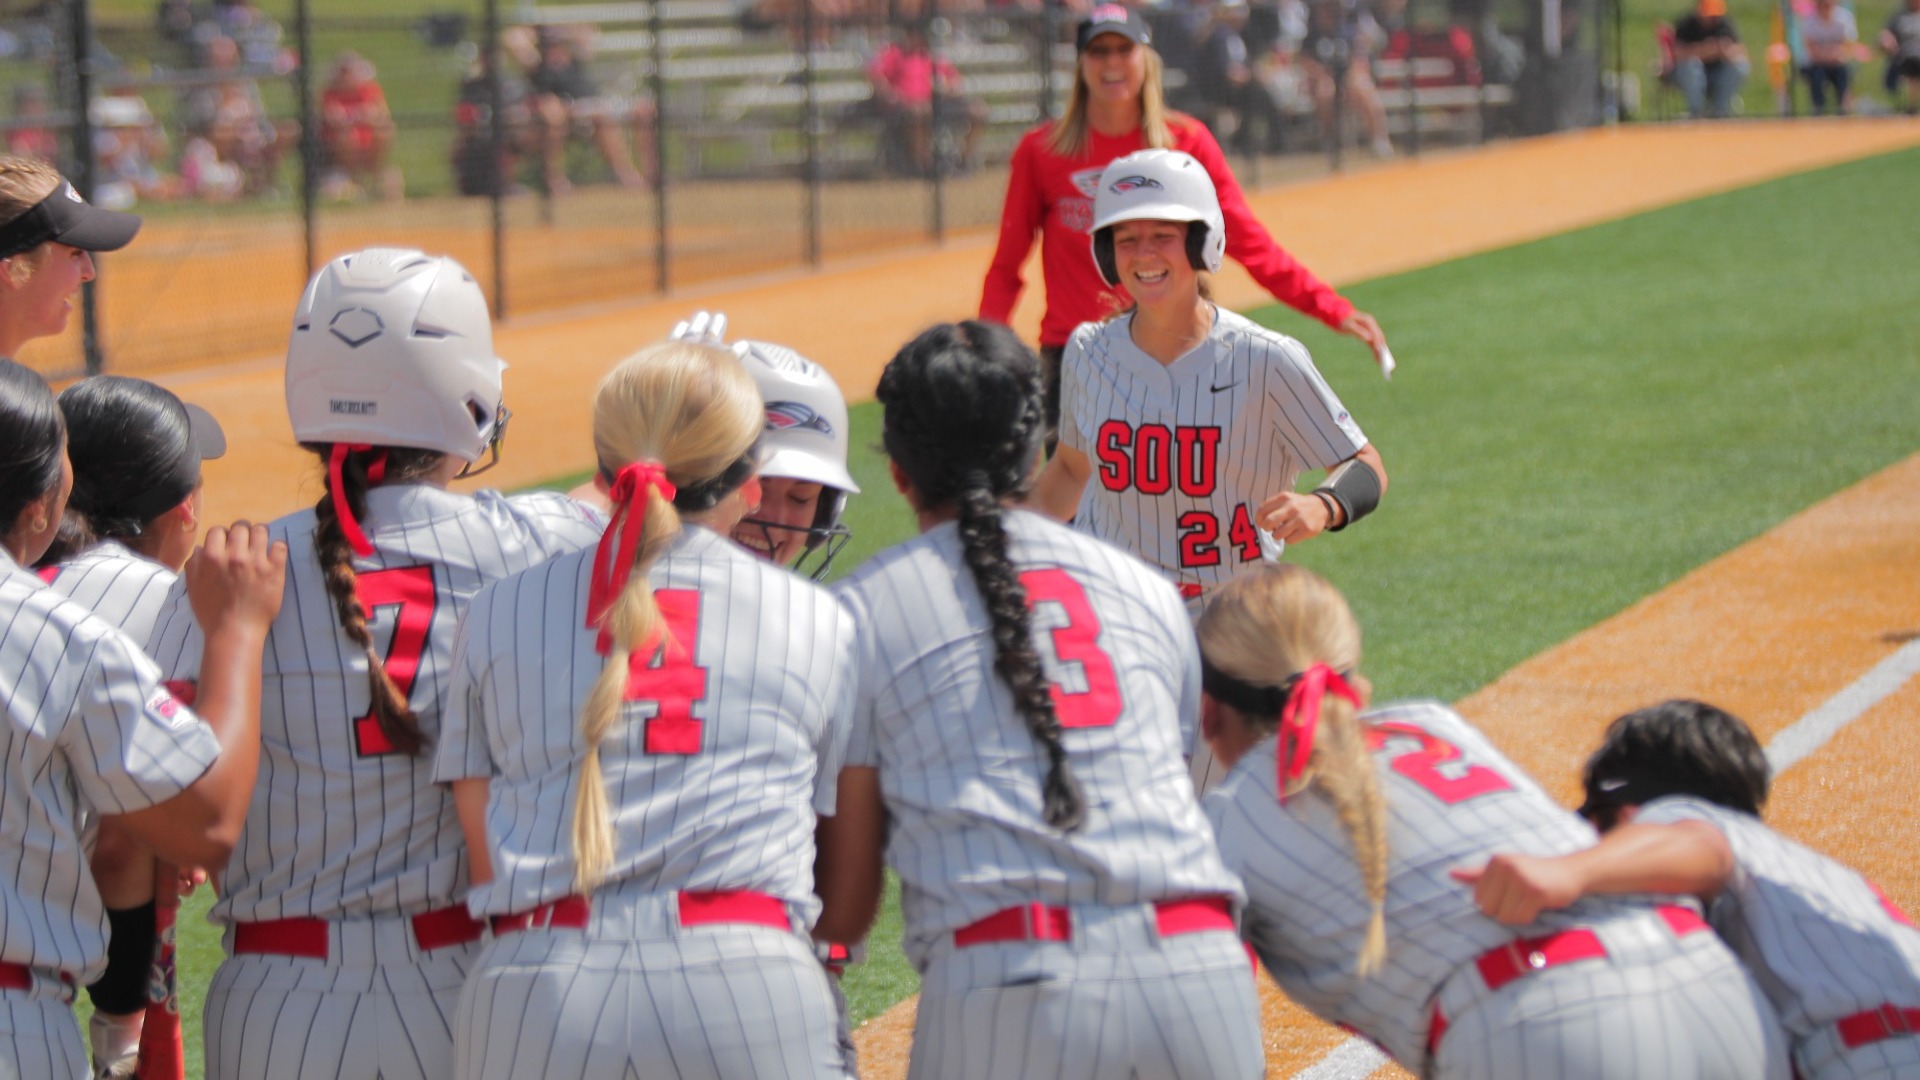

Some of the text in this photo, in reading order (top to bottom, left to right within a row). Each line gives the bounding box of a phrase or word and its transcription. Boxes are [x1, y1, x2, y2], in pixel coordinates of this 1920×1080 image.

[1096, 419, 1221, 497] SOU
[1178, 502, 1262, 568] 24
[353, 563, 438, 758] 7
[623, 587, 709, 756] 4
[1017, 568, 1125, 731] 3
[1363, 720, 1519, 806] 2
